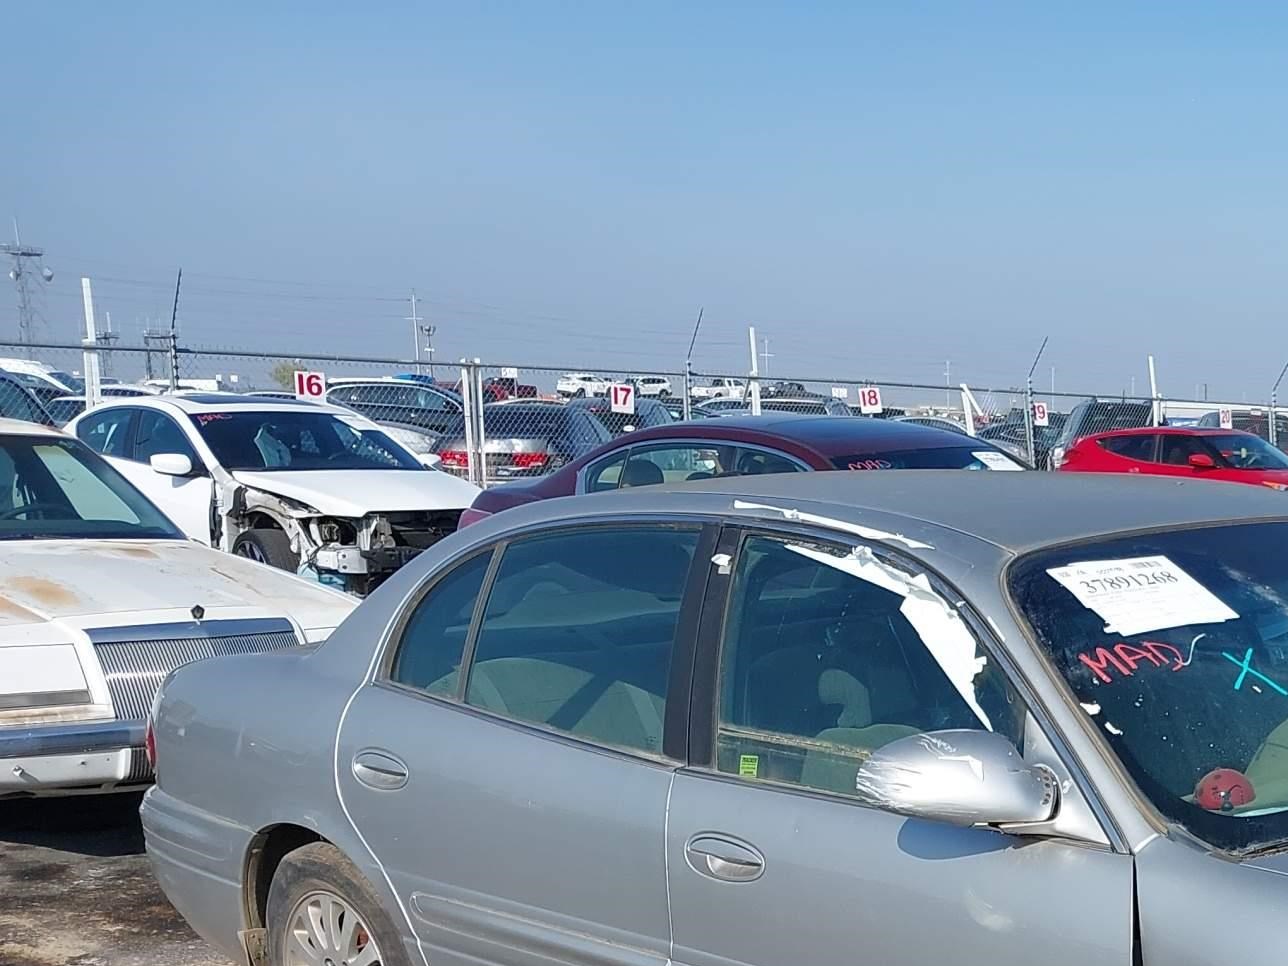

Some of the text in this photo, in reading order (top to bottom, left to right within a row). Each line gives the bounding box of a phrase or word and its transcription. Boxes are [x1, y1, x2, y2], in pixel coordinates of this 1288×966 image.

[298, 373, 323, 397] 16
[613, 386, 632, 406] 17
[861, 389, 879, 407] 18
[1220, 409, 1231, 424] 20
[1079, 571, 1179, 595] 37891268
[1078, 640, 1190, 684] MAD
